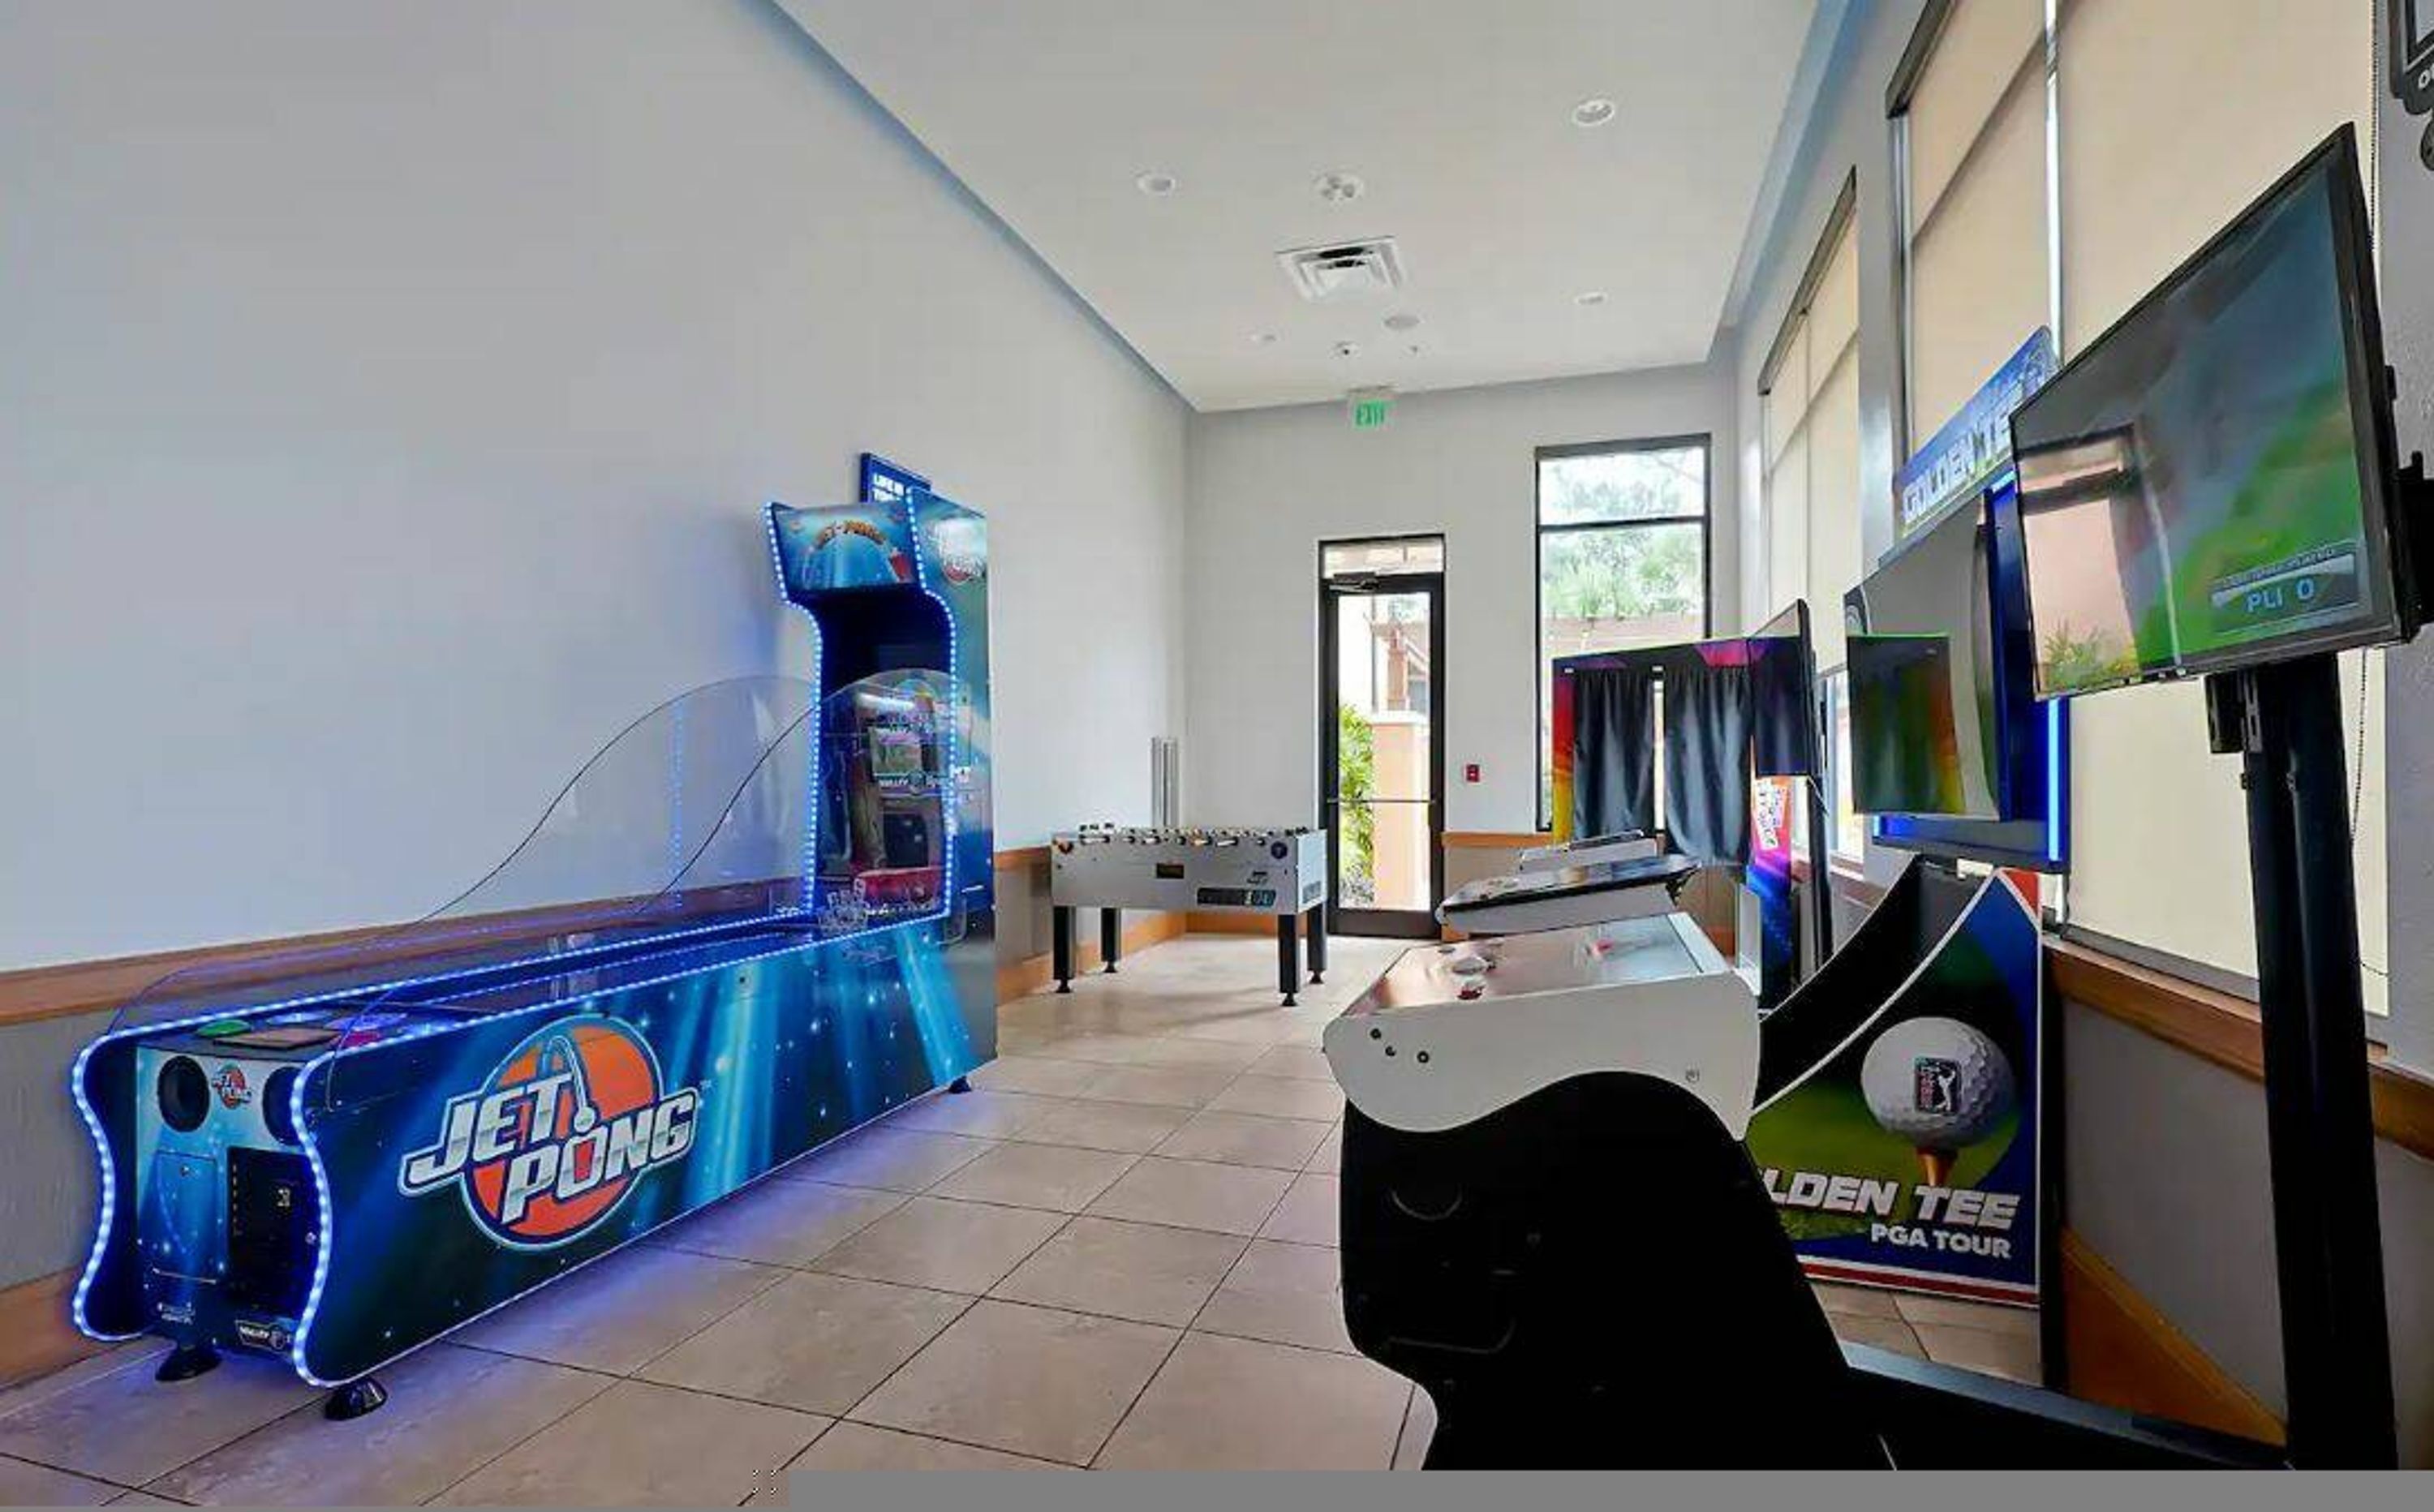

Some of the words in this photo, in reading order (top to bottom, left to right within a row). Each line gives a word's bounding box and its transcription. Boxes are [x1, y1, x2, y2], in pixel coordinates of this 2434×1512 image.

[408, 1072, 574, 1184] JET
[501, 1092, 695, 1226] PONG
[1760, 1168, 1899, 1217] LDEN
[1913, 1185, 2021, 1231] TEE
[1871, 1222, 1928, 1248] PGA
[1936, 1230, 2011, 1260] TOUR
